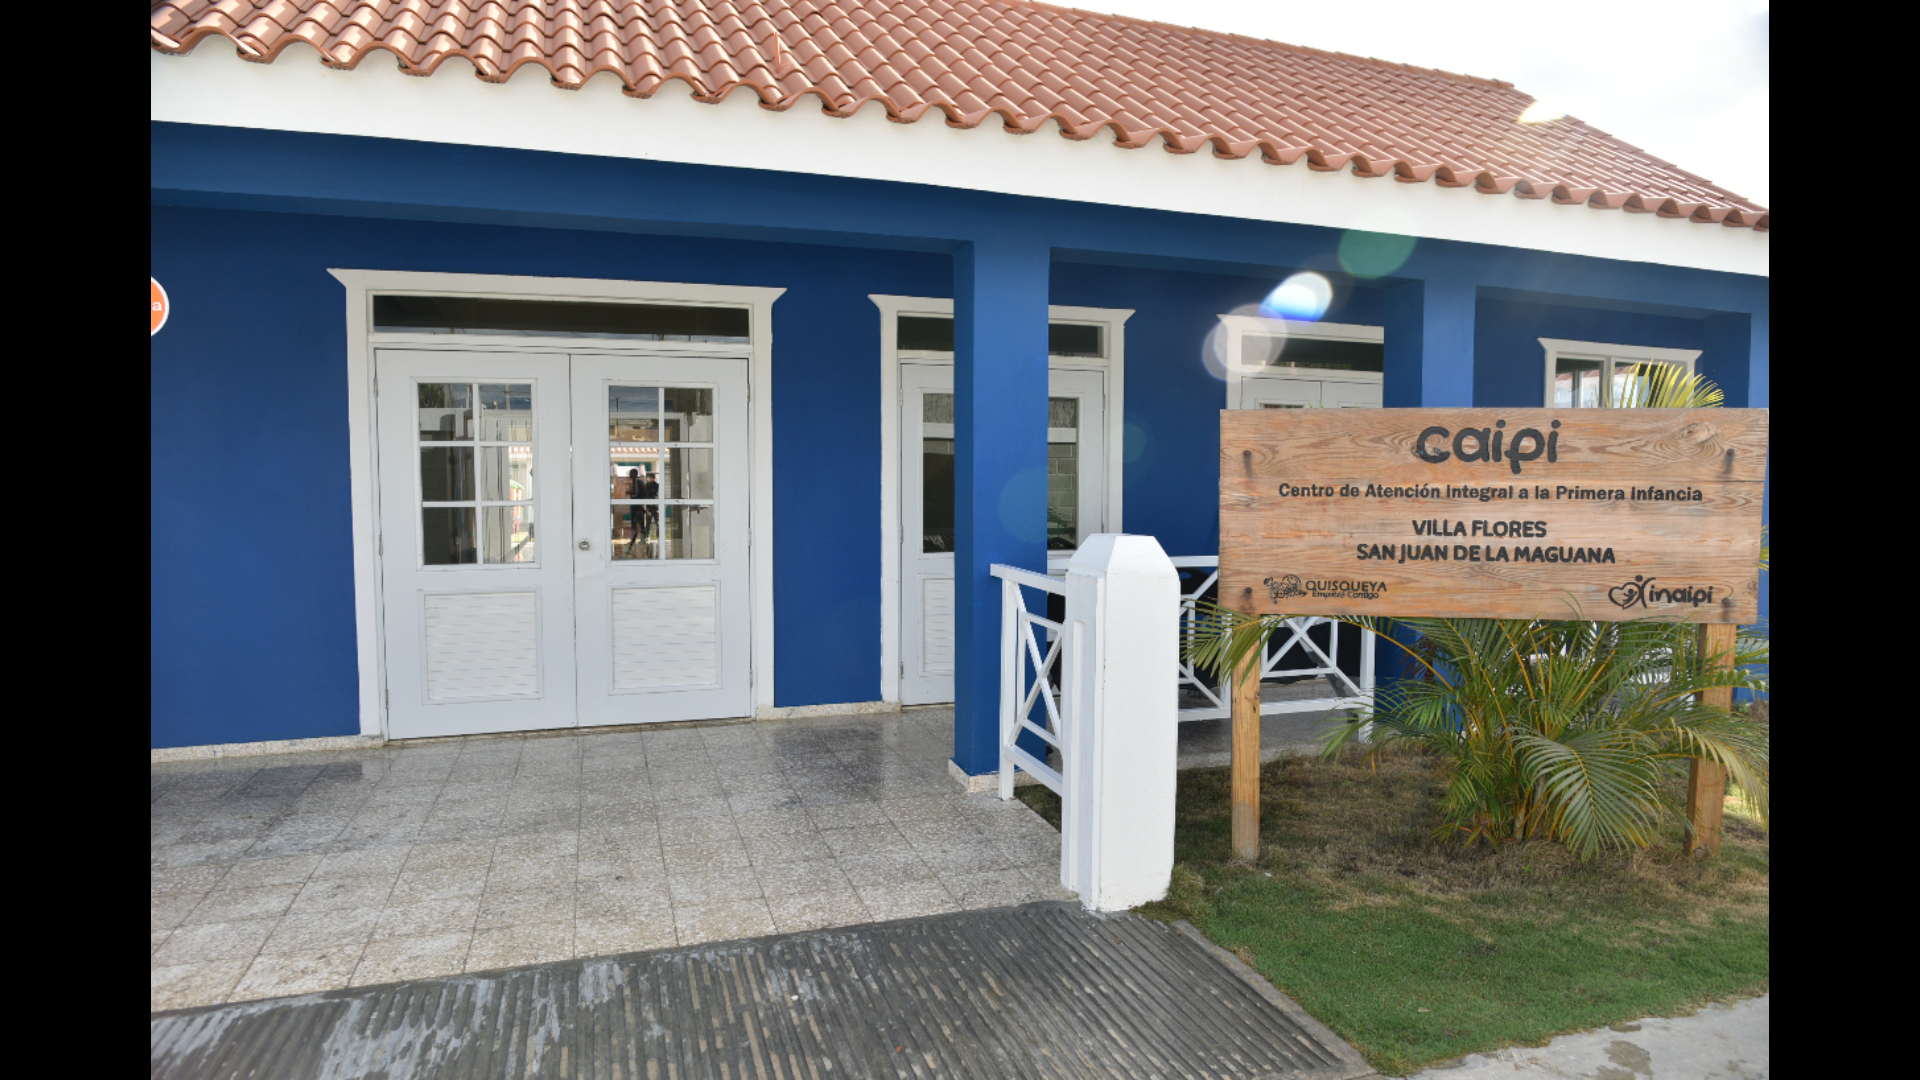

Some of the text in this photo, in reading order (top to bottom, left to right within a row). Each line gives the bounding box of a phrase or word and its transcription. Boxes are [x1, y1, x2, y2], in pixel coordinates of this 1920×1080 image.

[1417, 419, 1562, 475] caipi
[1278, 482, 1703, 503] Centro de Atención Integral a la Primera Infancia
[1412, 519, 1547, 538] VILLA FLORES
[1356, 543, 1616, 564] SAN JUAN DE LA MAGUANA
[1305, 580, 1388, 592] QUISQUEYA
[1648, 584, 1714, 608] inaipi
